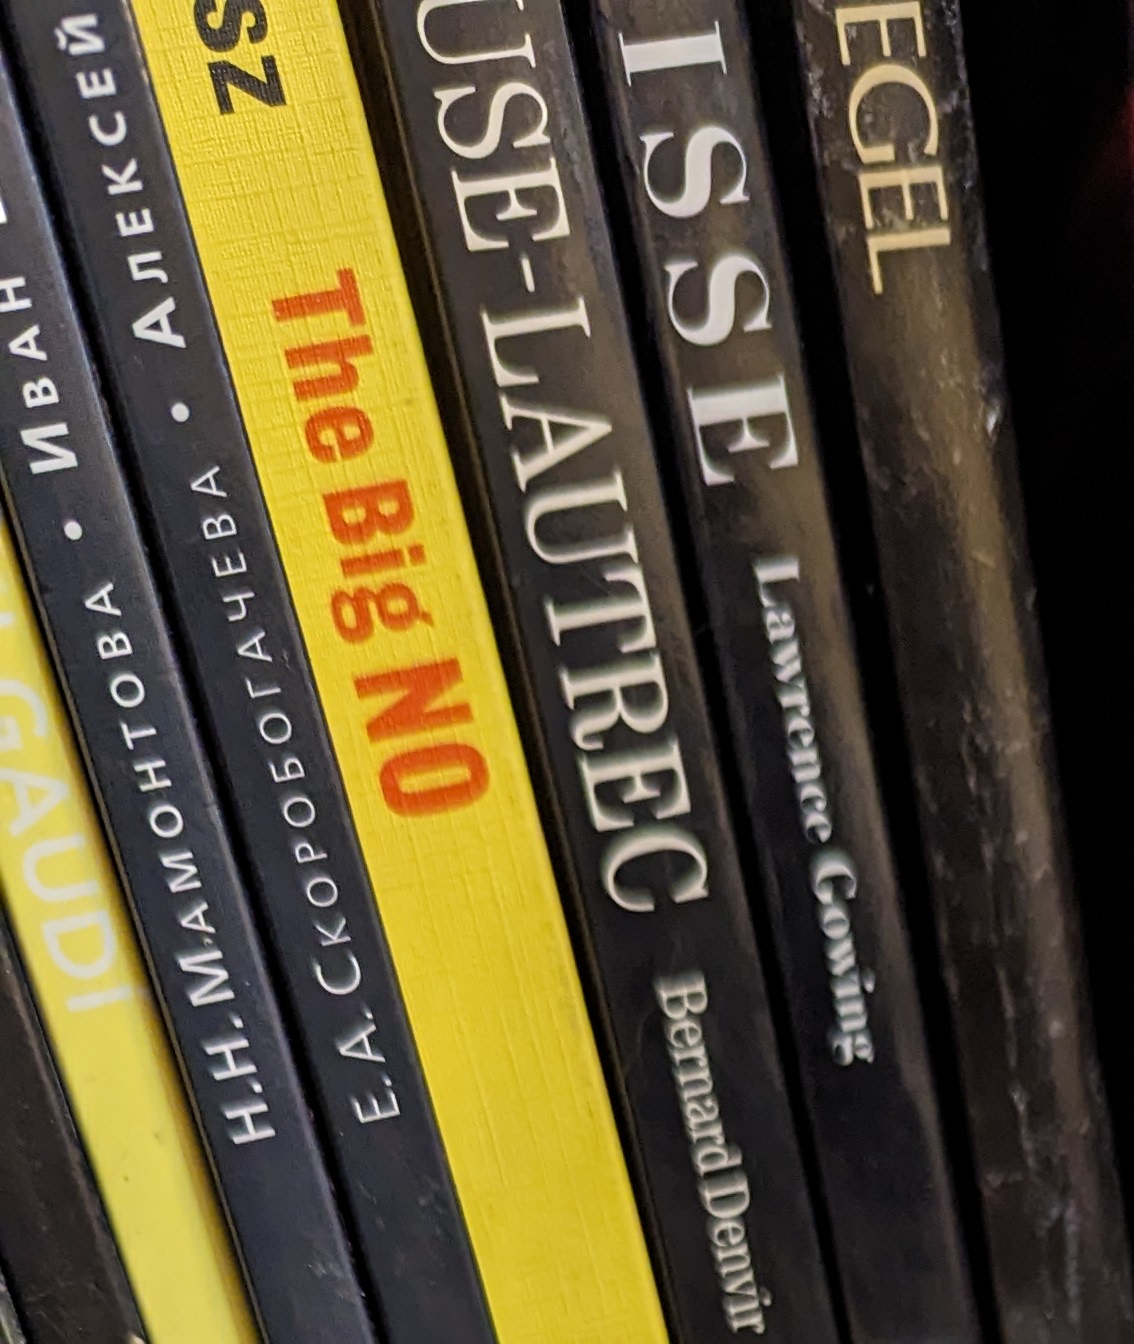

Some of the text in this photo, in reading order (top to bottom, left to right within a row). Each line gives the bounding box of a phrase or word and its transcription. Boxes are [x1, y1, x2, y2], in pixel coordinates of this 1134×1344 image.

[54, 13, 186, 349] АЛЕКСЕЙ
[835, 1, 951, 296] EGEL
[0, 276, 78, 474] ИВАН
[272, 267, 490, 819] The Big NO
[618, 20, 876, 1067] ISSE Lawrence Cowing
[416, 0, 772, 1335] USE-LAUTREC Bernard Denvir
